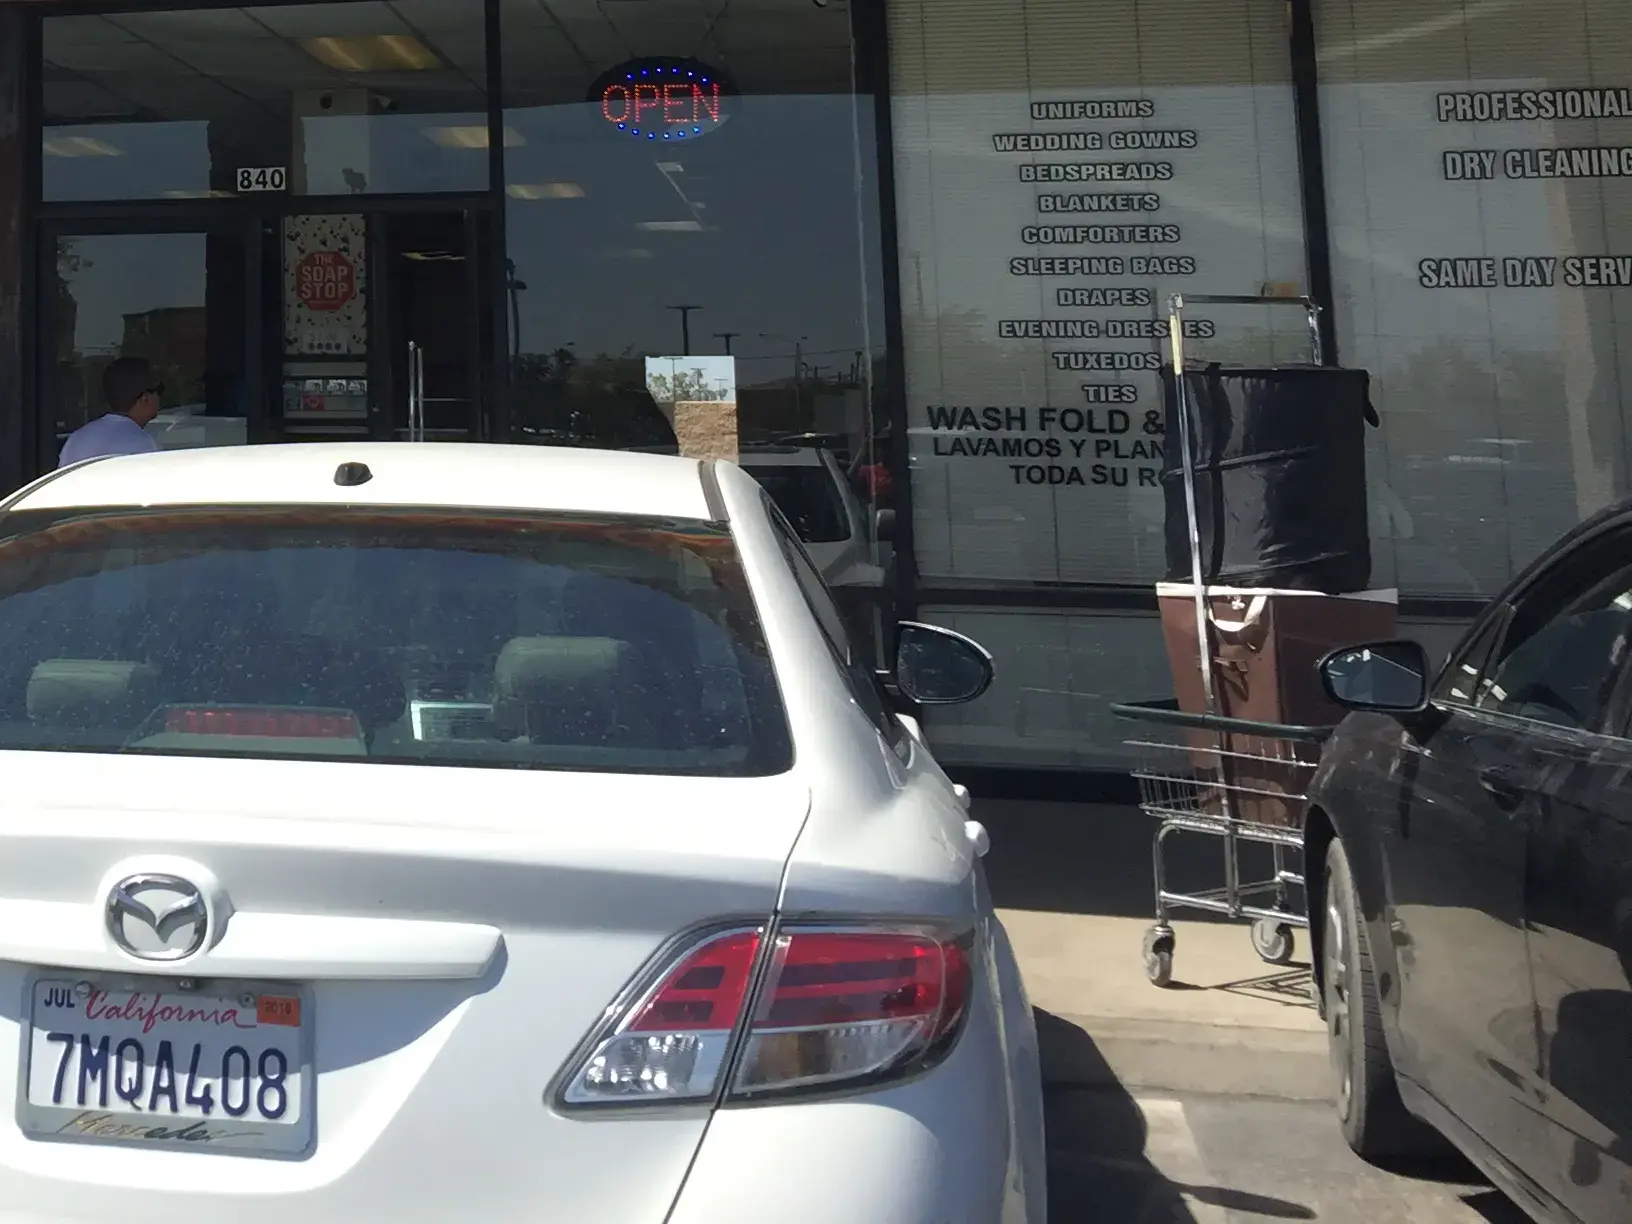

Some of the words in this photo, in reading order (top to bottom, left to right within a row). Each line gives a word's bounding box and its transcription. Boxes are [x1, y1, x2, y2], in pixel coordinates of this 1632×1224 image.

[601, 82, 720, 123] OPEN
[1030, 99, 1155, 120] UNIFORMS
[1436, 88, 1632, 123] PROFESSIONAL
[993, 132, 1103, 152] WEDDING
[1108, 129, 1198, 149] GOWNS
[1019, 161, 1174, 183] BEDSPREADS
[1443, 150, 1497, 180] DRY
[1503, 147, 1632, 179] CLEANING
[238, 168, 285, 191] 840
[1036, 192, 1160, 212] BLANKETS
[1021, 224, 1181, 244] COMFORTERS
[314, 253, 335, 265] THE
[1009, 256, 1124, 276] SLEEPING
[1130, 255, 1197, 275] BAGS
[300, 265, 349, 284] SOAP
[1419, 258, 1498, 289] SAME
[1503, 258, 1557, 288] DAY
[1564, 257, 1632, 288] SERV
[300, 284, 349, 300] STOP
[1056, 287, 1151, 307] DRAPES
[998, 319, 1101, 339] EVENING
[1107, 320, 1215, 338] DRESES
[1052, 351, 1161, 370] TUXEDOS
[1082, 384, 1138, 403] TIES
[927, 406, 1027, 432] WASH
[1039, 408, 1130, 434] FOLD
[1143, 410, 1165, 435] &
[933, 437, 1061, 458] LAVAMOS
[1068, 438, 1086, 458] Y
[1009, 464, 1085, 485] TODA
[1091, 464, 1128, 487] SU
[43, 987, 76, 1009] JUL
[84, 987, 258, 1033] California
[46, 1032, 289, 1120] 7MQA408
